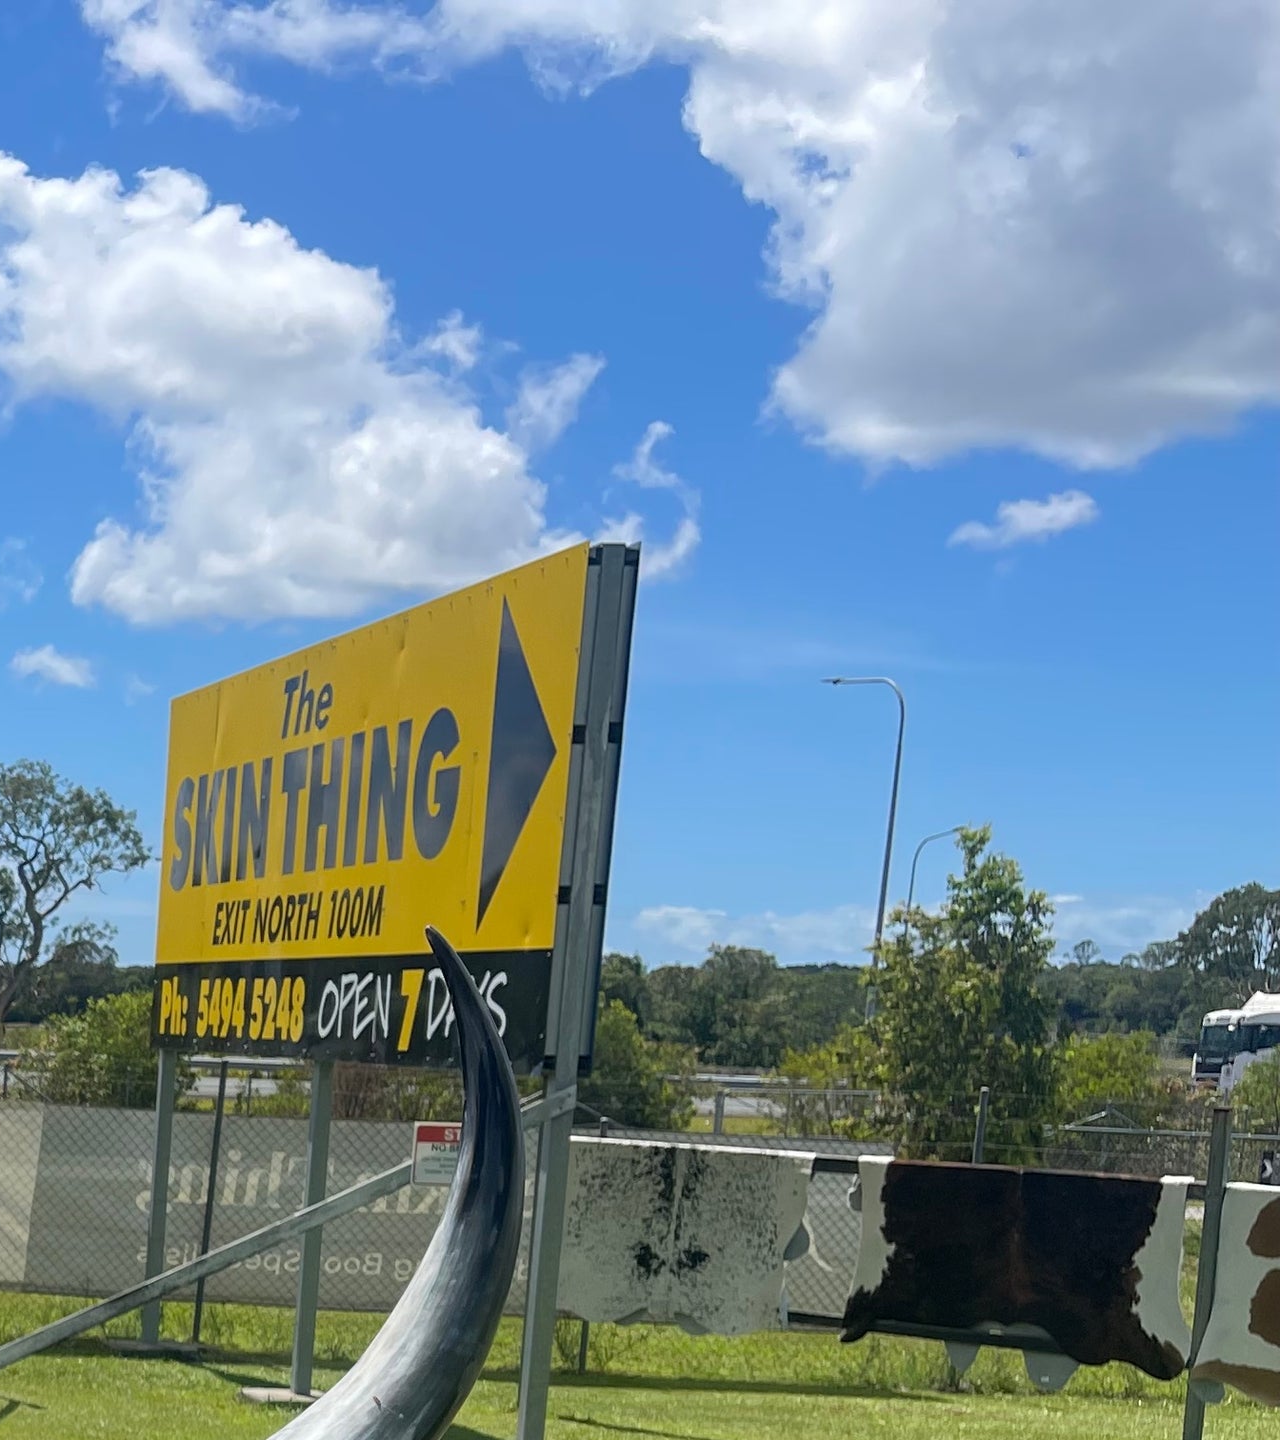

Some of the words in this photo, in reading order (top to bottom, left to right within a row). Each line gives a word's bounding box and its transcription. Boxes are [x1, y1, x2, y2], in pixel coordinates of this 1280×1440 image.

[281, 670, 333, 739] The
[170, 757, 273, 892] SKIN
[282, 707, 461, 876] THING
[212, 899, 251, 945] EXIT
[252, 891, 323, 944] NORTH
[328, 885, 385, 939] 100M
[159, 975, 188, 1036] Ph:
[196, 977, 245, 1039] 5494
[248, 975, 305, 1043] 5248
[317, 971, 391, 1043] OPEN
[397, 968, 425, 1051] 7
[426, 968, 508, 1041] DS
